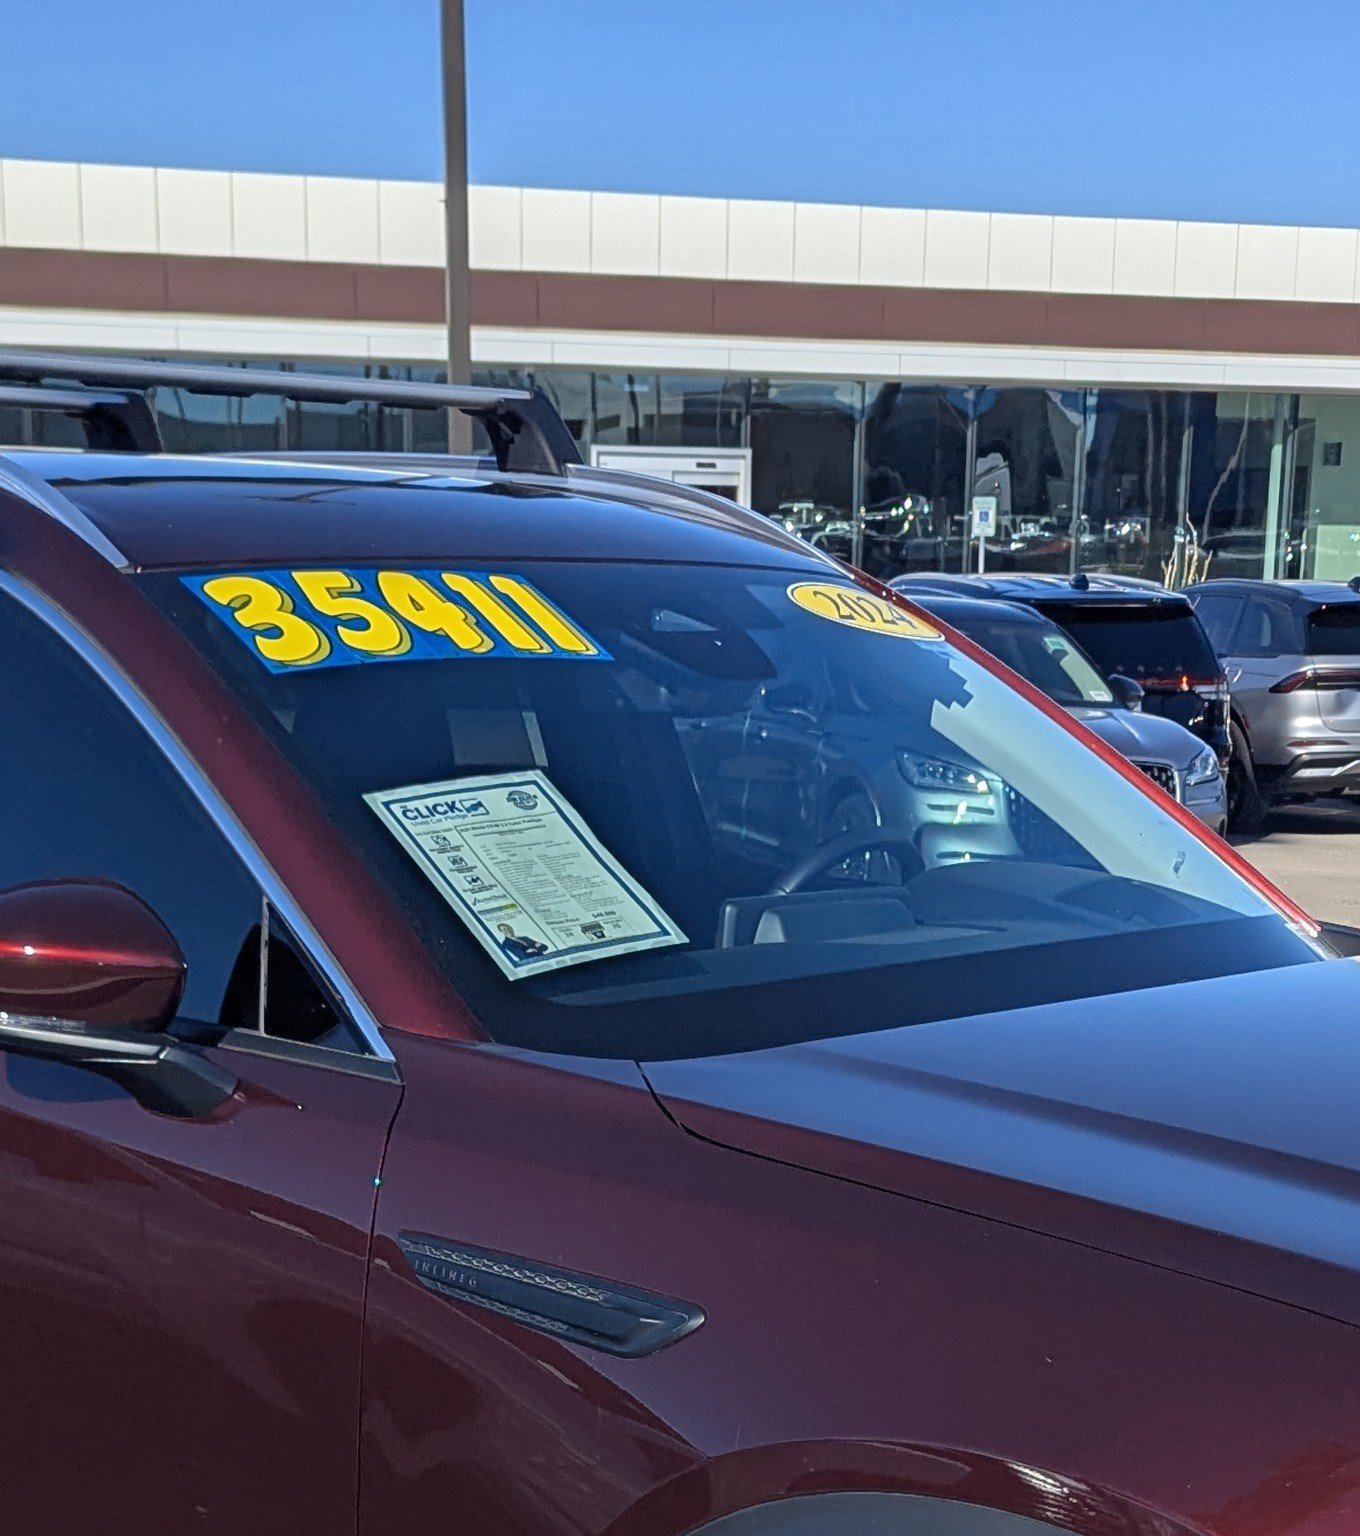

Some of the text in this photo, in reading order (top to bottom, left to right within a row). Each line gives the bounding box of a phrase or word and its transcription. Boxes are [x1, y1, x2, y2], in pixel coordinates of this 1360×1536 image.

[202, 570, 600, 666] 35411
[812, 590, 918, 630] 2024
[401, 800, 464, 821] CLICK
